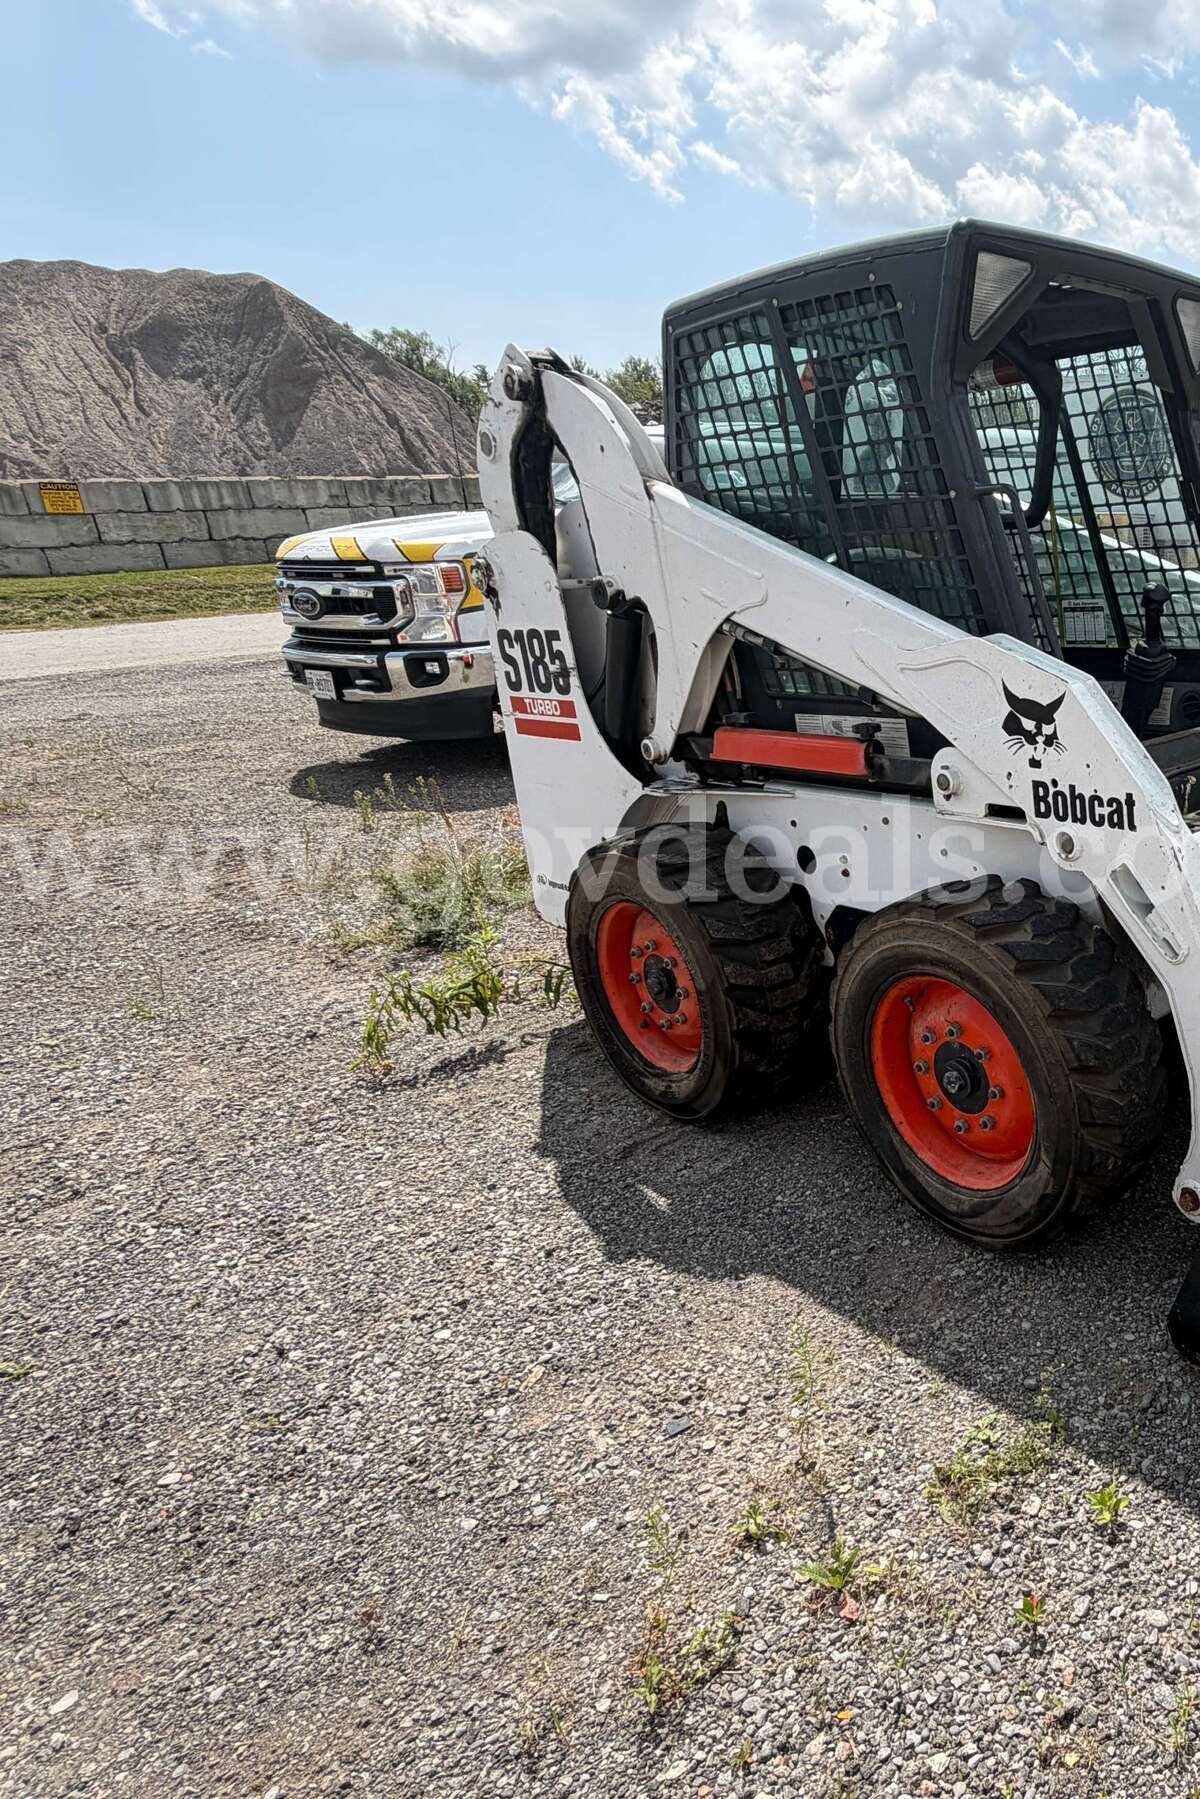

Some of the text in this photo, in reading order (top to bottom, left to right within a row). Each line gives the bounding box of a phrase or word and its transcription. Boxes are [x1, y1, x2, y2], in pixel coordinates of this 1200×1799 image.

[496, 628, 572, 696] S185
[523, 698, 561, 716] TURBO
[1031, 779, 1138, 832] Bobcat
